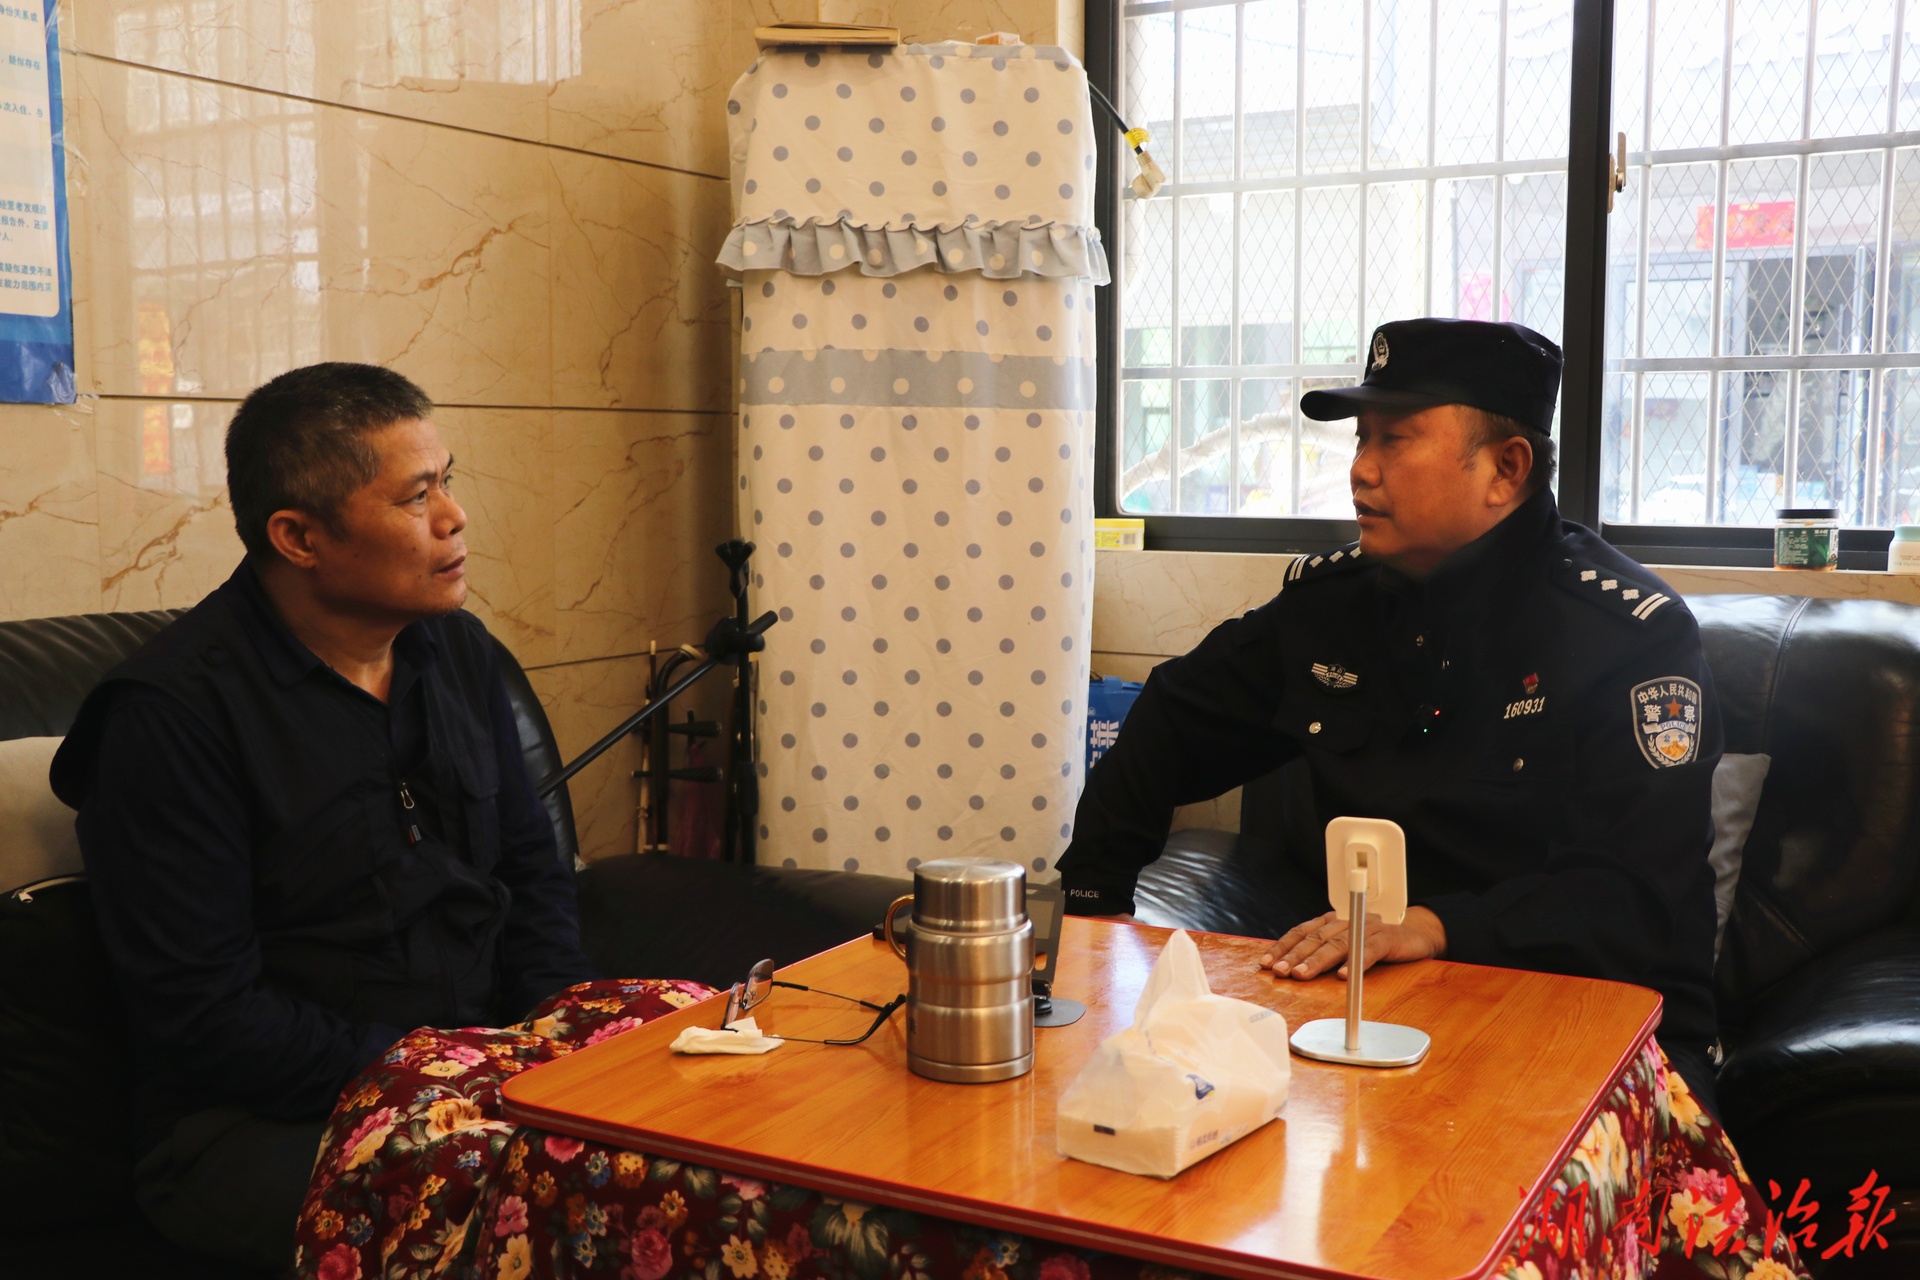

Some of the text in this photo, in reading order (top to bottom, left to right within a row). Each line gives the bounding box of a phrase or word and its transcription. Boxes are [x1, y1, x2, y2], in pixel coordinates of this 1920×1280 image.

[1637, 683, 1697, 705] 中华人民共和国
[1503, 696, 1546, 719] 160931
[1070, 888, 1100, 899] POLICE
